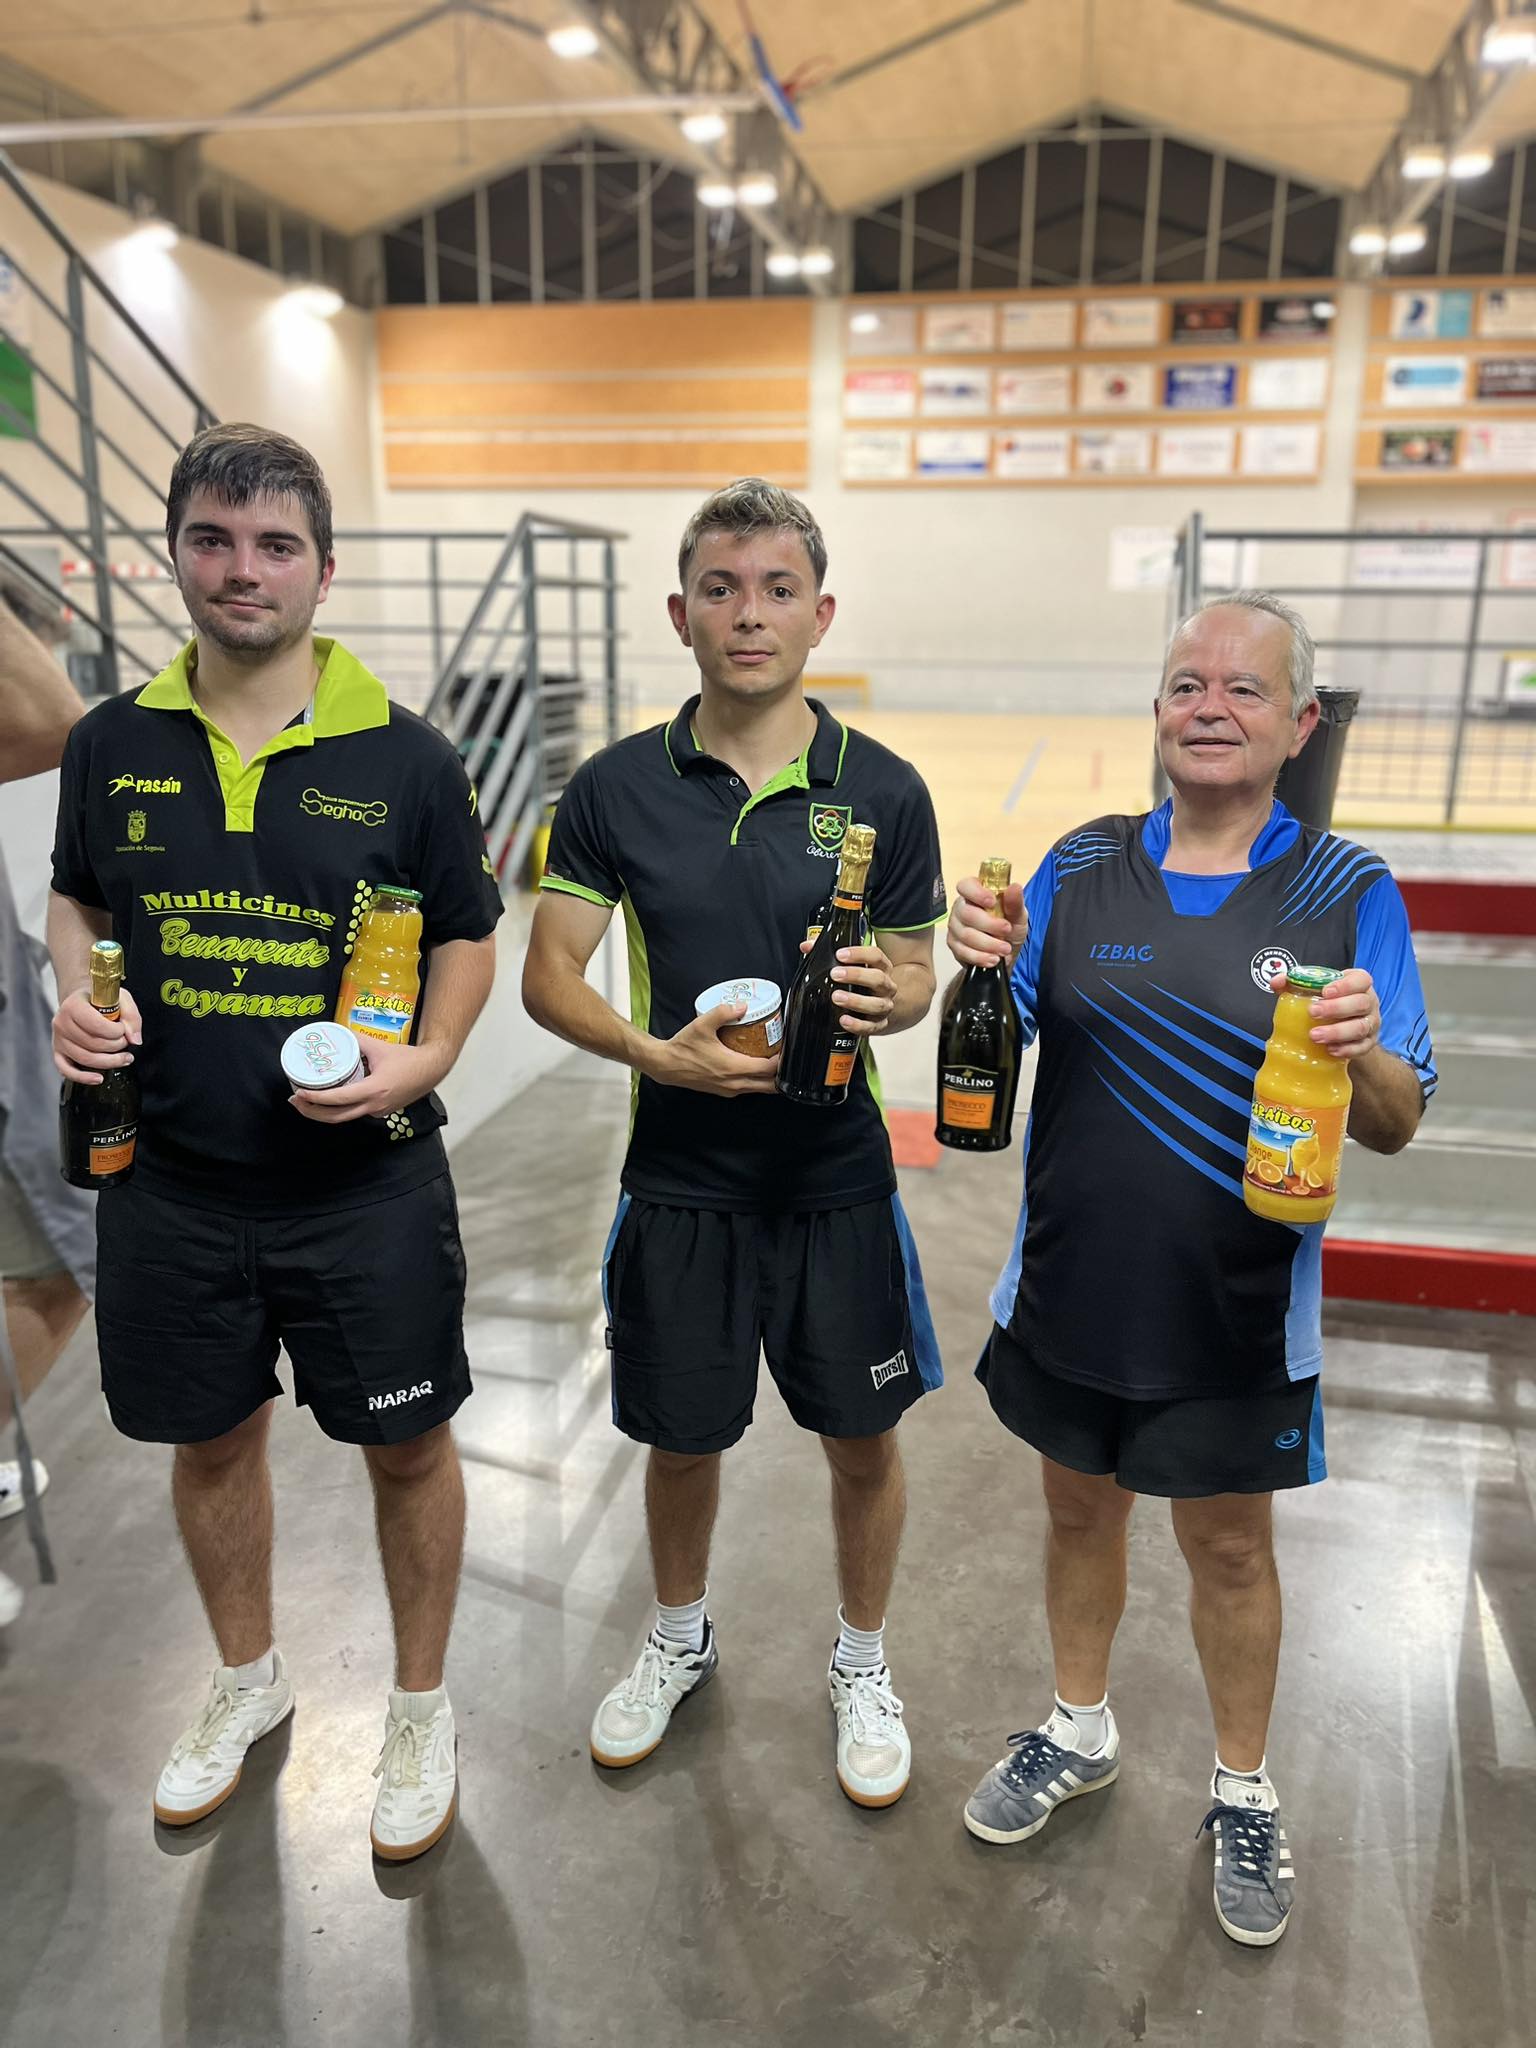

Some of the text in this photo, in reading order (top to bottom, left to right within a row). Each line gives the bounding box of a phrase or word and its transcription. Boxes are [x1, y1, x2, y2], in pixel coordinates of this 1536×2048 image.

[139, 889, 336, 926] Multicines
[160, 917, 330, 968] Benavente
[231, 967, 249, 987] y
[160, 978, 326, 1018] Coyanza
[944, 1073, 994, 1088] PERLINO
[93, 1126, 137, 1144] PERLINO
[368, 1380, 434, 1411] NARAQ
